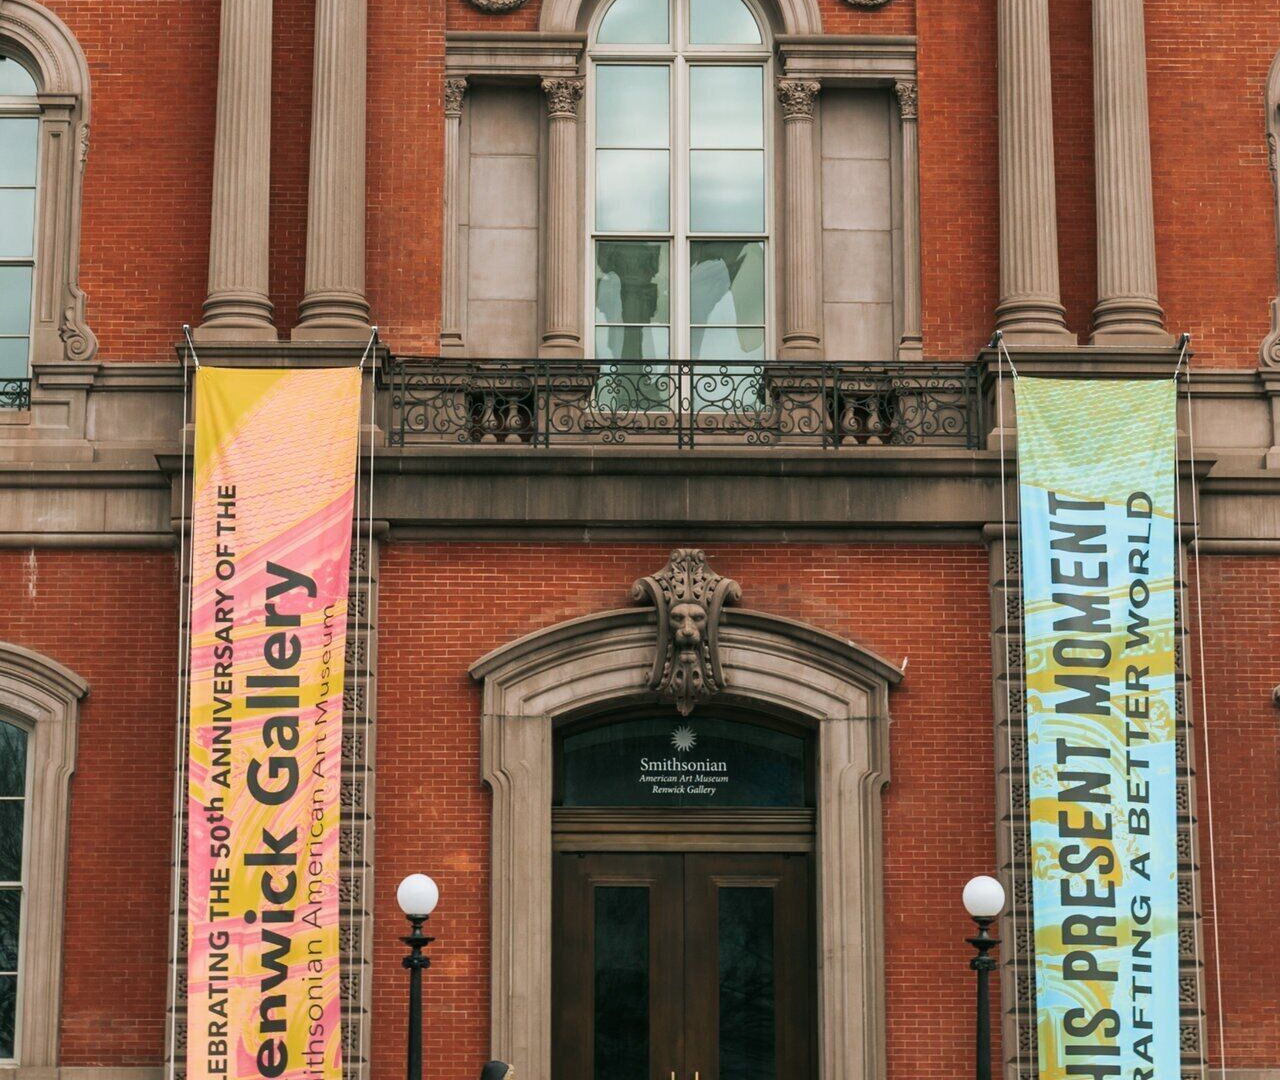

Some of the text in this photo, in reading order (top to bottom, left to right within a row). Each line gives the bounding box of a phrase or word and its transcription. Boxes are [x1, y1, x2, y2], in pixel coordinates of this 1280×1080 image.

[1047, 491, 1112, 716] MOMENT
[1125, 491, 1153, 650] WORLD
[204, 485, 237, 1080] EBRATING THE 50th ANNIVERSARY OF THE
[244, 560, 318, 1080] enwick Gallery
[639, 774, 729, 783] American Art Museum
[640, 757, 727, 771] Smithsonian
[652, 785, 717, 796] Renwick Gallery
[1125, 664, 1150, 836] BETTER
[301, 604, 335, 1080] ithsonian American Art Museum
[1056, 737, 1119, 982] PRESENT
[1130, 851, 1150, 881] A
